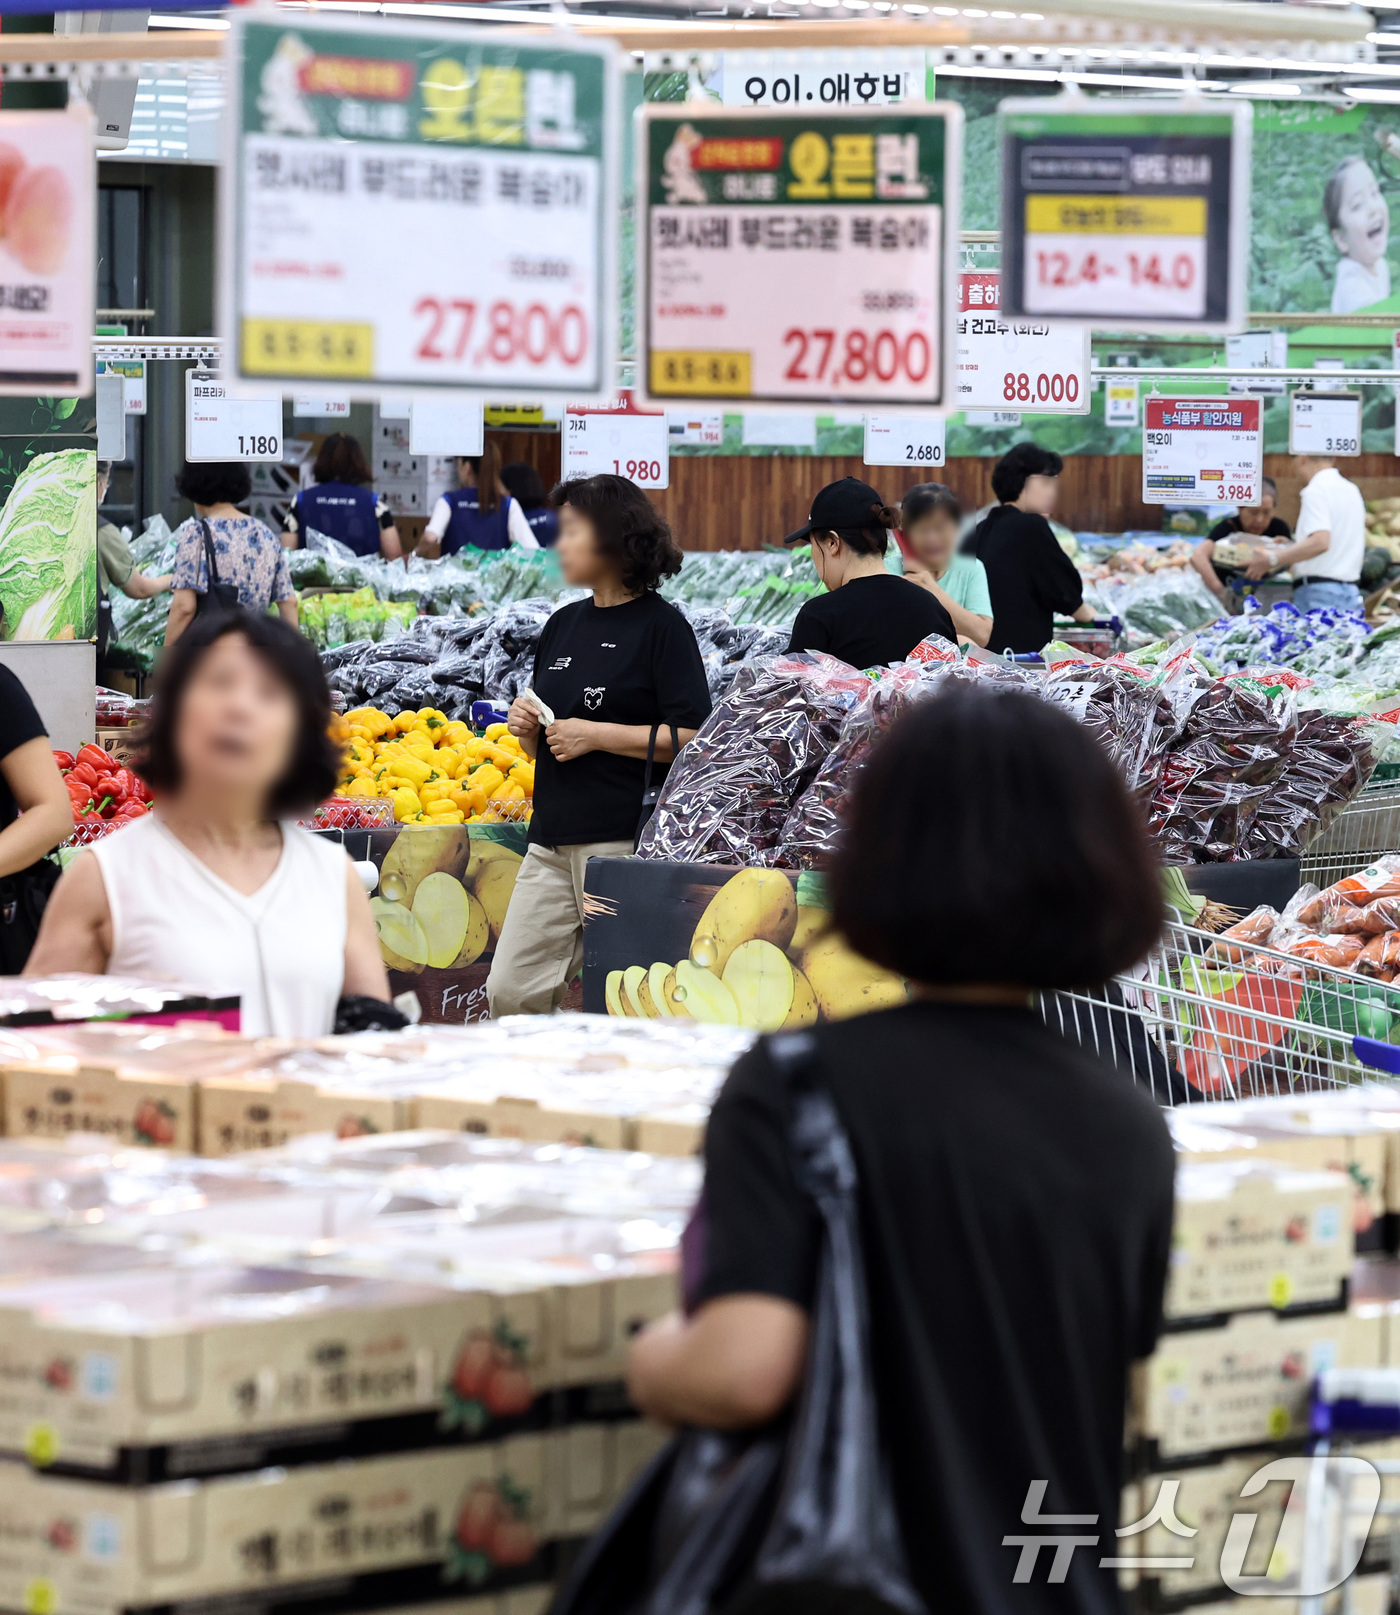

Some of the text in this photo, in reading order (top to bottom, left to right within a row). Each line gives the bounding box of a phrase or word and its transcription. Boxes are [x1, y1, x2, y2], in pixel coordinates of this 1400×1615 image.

[787, 131, 929, 199] 오픈런
[739, 214, 840, 250] 부드러운
[853, 214, 929, 249] 복숭아
[414, 294, 589, 369] 27,800
[784, 326, 931, 387] 27,800
[194, 386, 226, 398] 파프리카
[1003, 372, 1079, 403] 88,000
[569, 420, 587, 431] 가지
[1162, 410, 1243, 427] 농식품부 할인지원
[238, 435, 278, 456] 1,180
[1147, 433, 1172, 446] 백오이
[1326, 438, 1357, 451] 3,580
[906, 444, 941, 460] 2,680
[613, 459, 661, 481] 1,980
[1217, 485, 1253, 500] 3,984
[441, 984, 488, 1016] Fres
[464, 1003, 490, 1027] Fo
